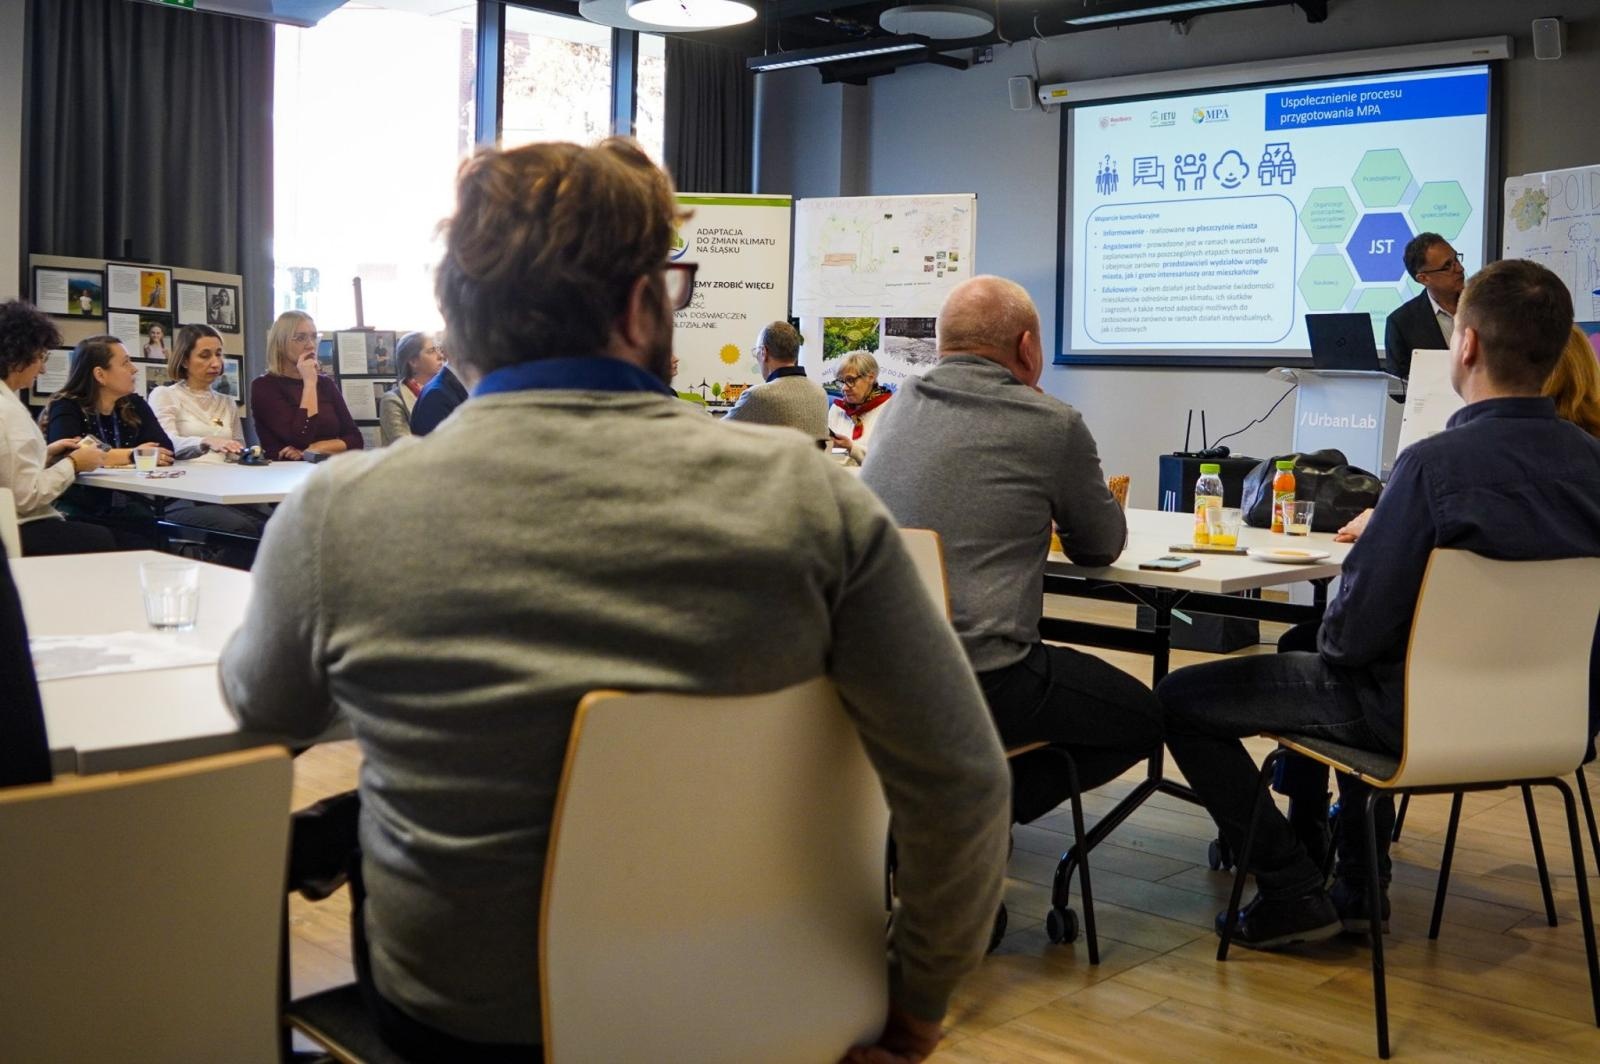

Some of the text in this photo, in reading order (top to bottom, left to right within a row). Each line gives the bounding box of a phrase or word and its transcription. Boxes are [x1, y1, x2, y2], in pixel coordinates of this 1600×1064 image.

[1281, 89, 1402, 109] Uspołecznienie procesu
[1205, 108, 1229, 119] MPA
[1280, 105, 1381, 125] przygotowania MPA
[710, 245, 740, 254] ŚLĄSKU
[1369, 239, 1394, 254] JST
[713, 280, 743, 288] ZROBIĆ
[745, 282, 774, 290] WIĘCEJ
[1351, 413, 1377, 429] Lab
